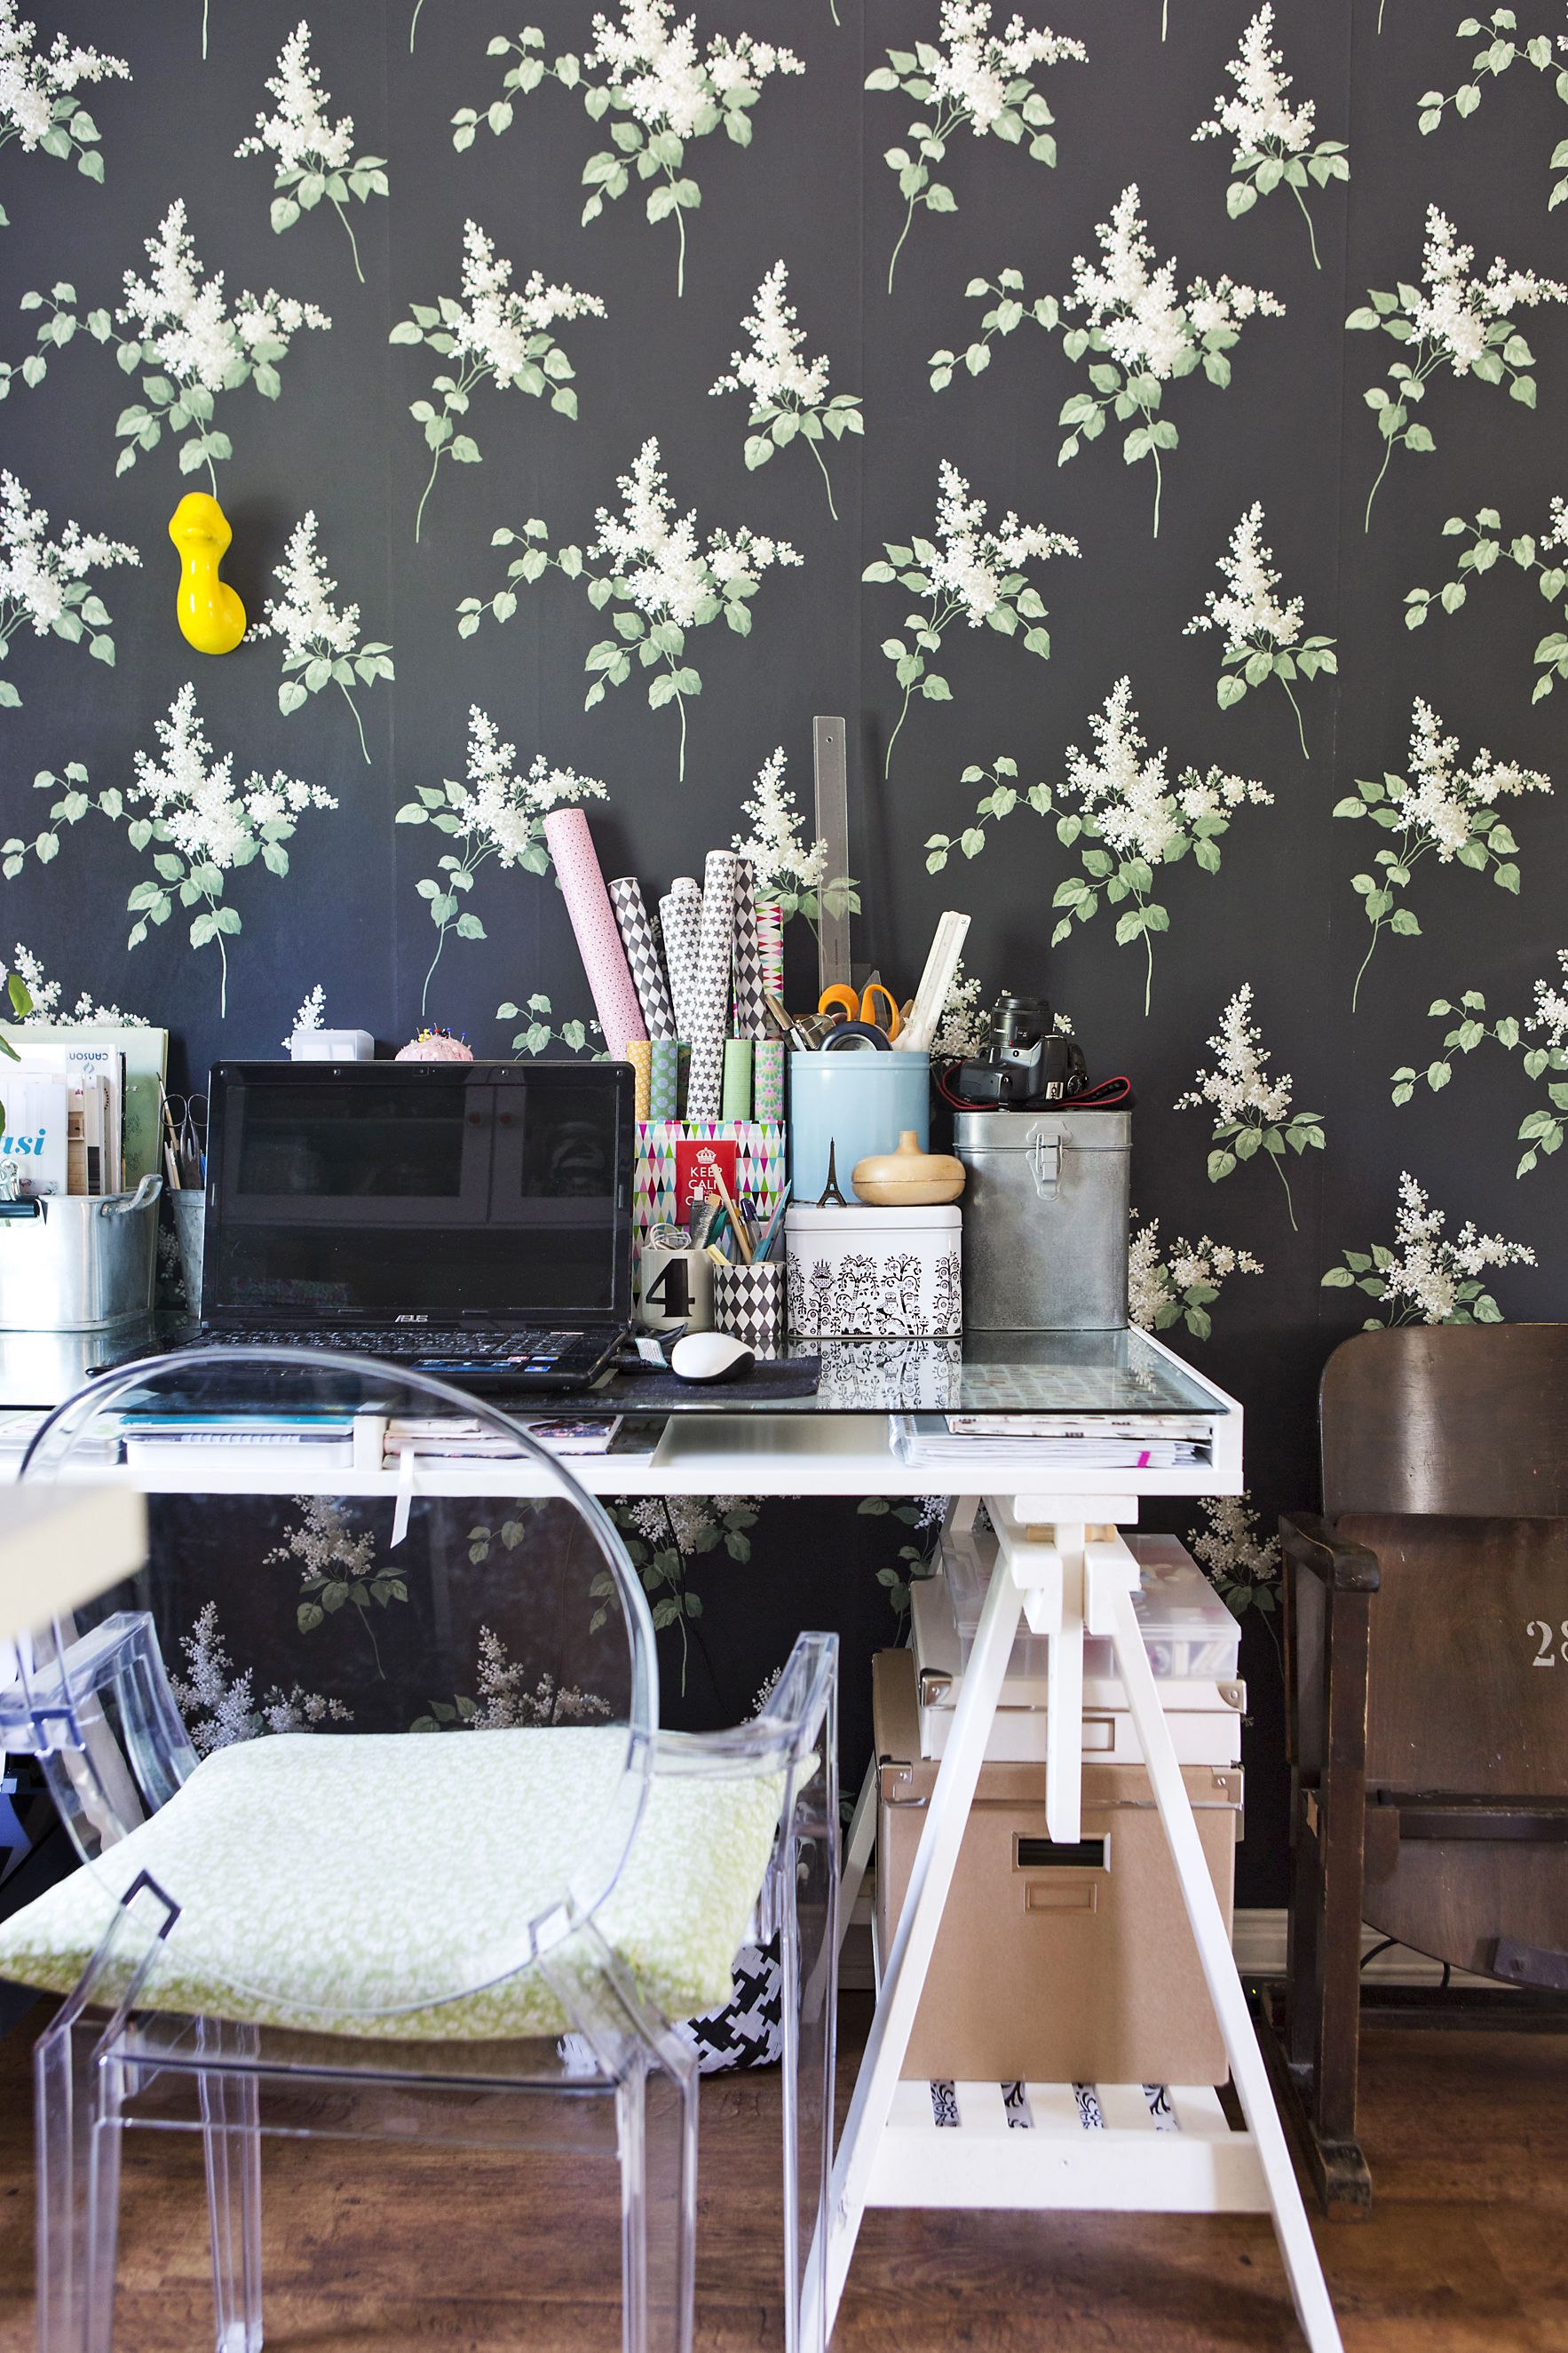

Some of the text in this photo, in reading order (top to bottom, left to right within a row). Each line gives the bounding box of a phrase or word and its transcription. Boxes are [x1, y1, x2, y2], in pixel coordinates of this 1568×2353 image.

[646, 1258, 695, 1318] 4
[394, 1314, 429, 1323] ASUS
[1526, 1620, 1568, 1667] 2
